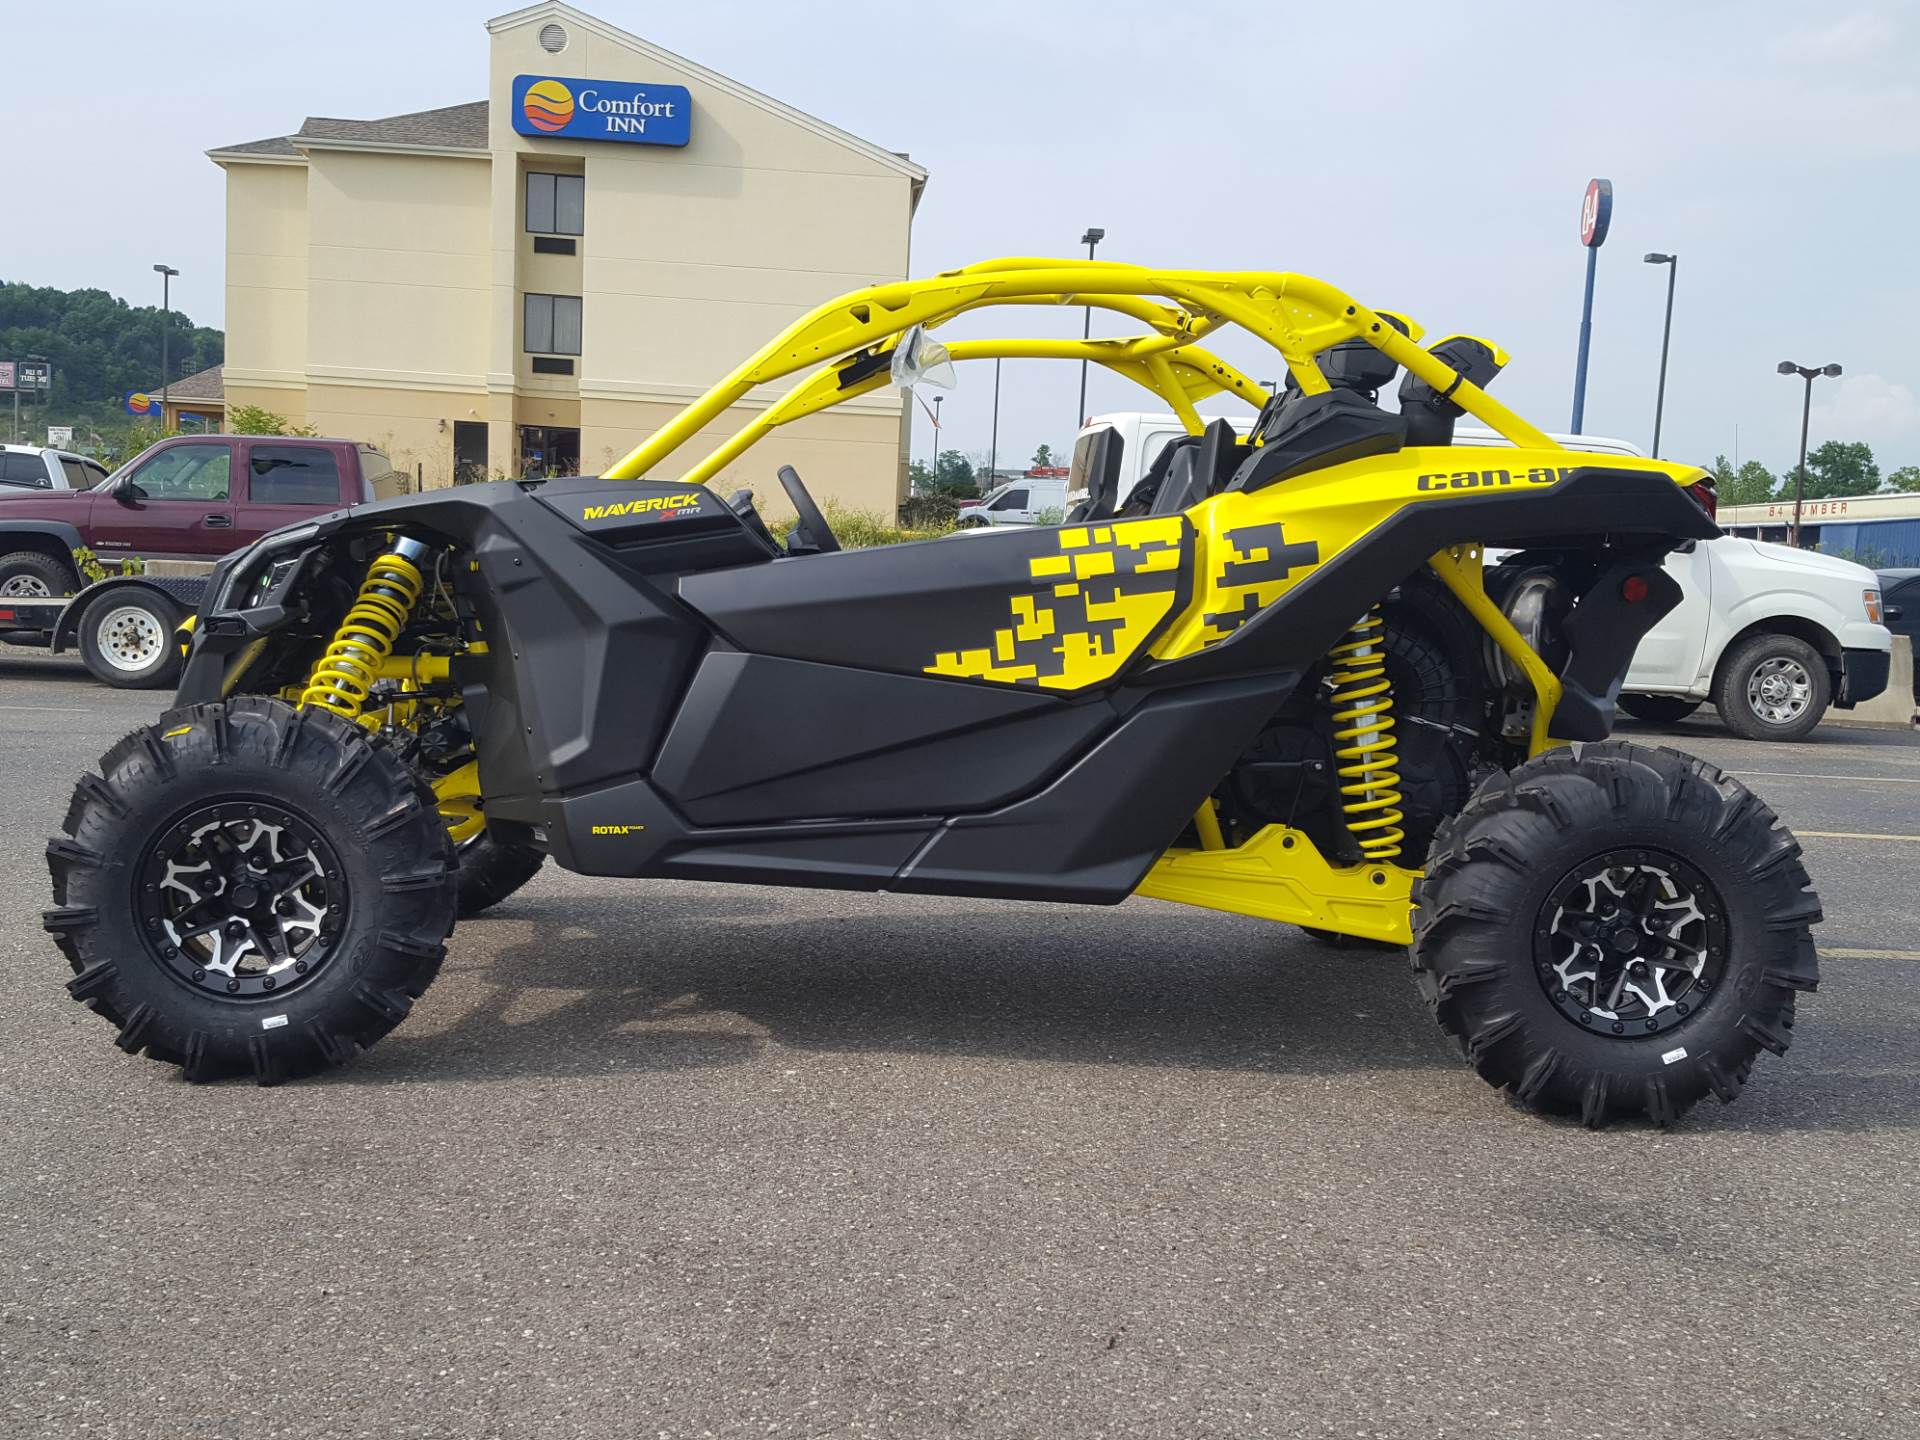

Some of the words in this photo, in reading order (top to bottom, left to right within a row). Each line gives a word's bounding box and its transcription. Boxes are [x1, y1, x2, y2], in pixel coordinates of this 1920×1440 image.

[578, 90, 676, 118] Comfort
[605, 117, 646, 134] INN
[1582, 188, 1599, 236] 84
[583, 492, 702, 520] MAVERICK
[1769, 506, 1784, 517] 84
[1791, 502, 1848, 517] LUMBER
[592, 826, 629, 835] ROTAX
